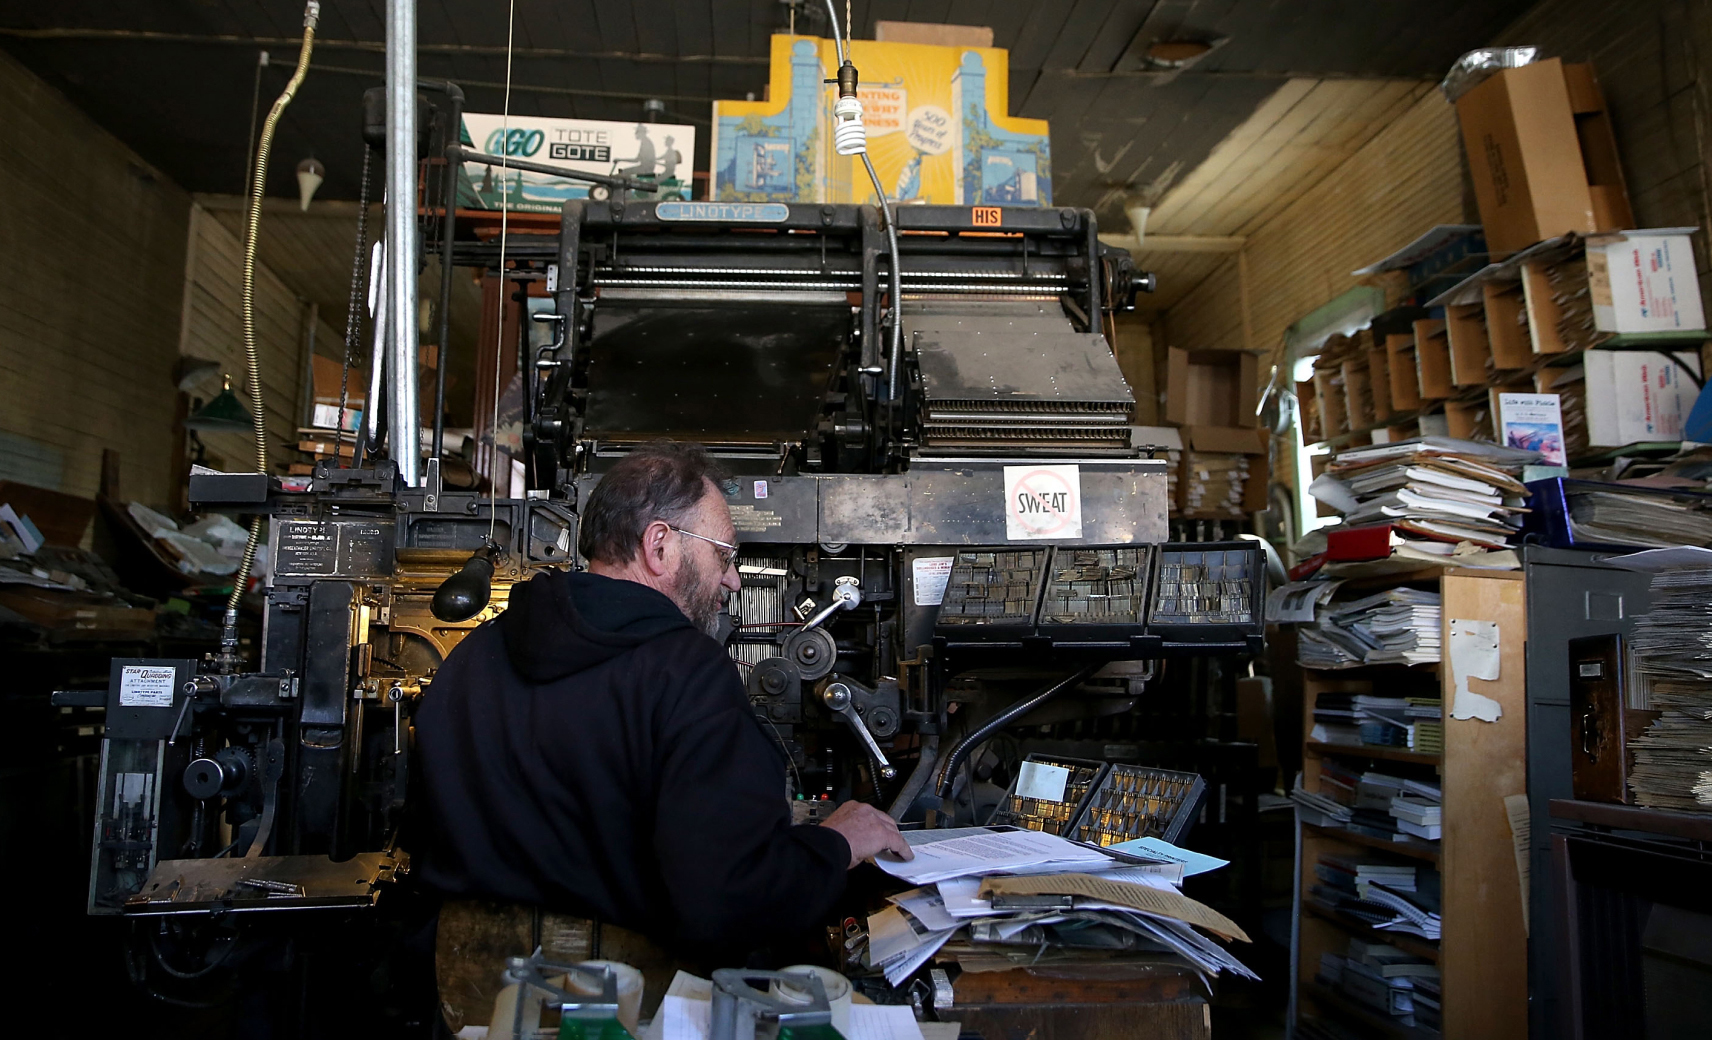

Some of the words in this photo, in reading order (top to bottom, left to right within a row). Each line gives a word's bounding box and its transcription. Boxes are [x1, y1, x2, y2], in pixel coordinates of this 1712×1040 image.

[924, 111, 947, 127] 500
[555, 129, 608, 144] TOTE
[552, 145, 609, 161] GOTE
[493, 201, 514, 209] THE
[680, 204, 764, 218] LINOTYPE
[975, 210, 998, 223] HIS
[1018, 492, 1068, 514] SWEAT
